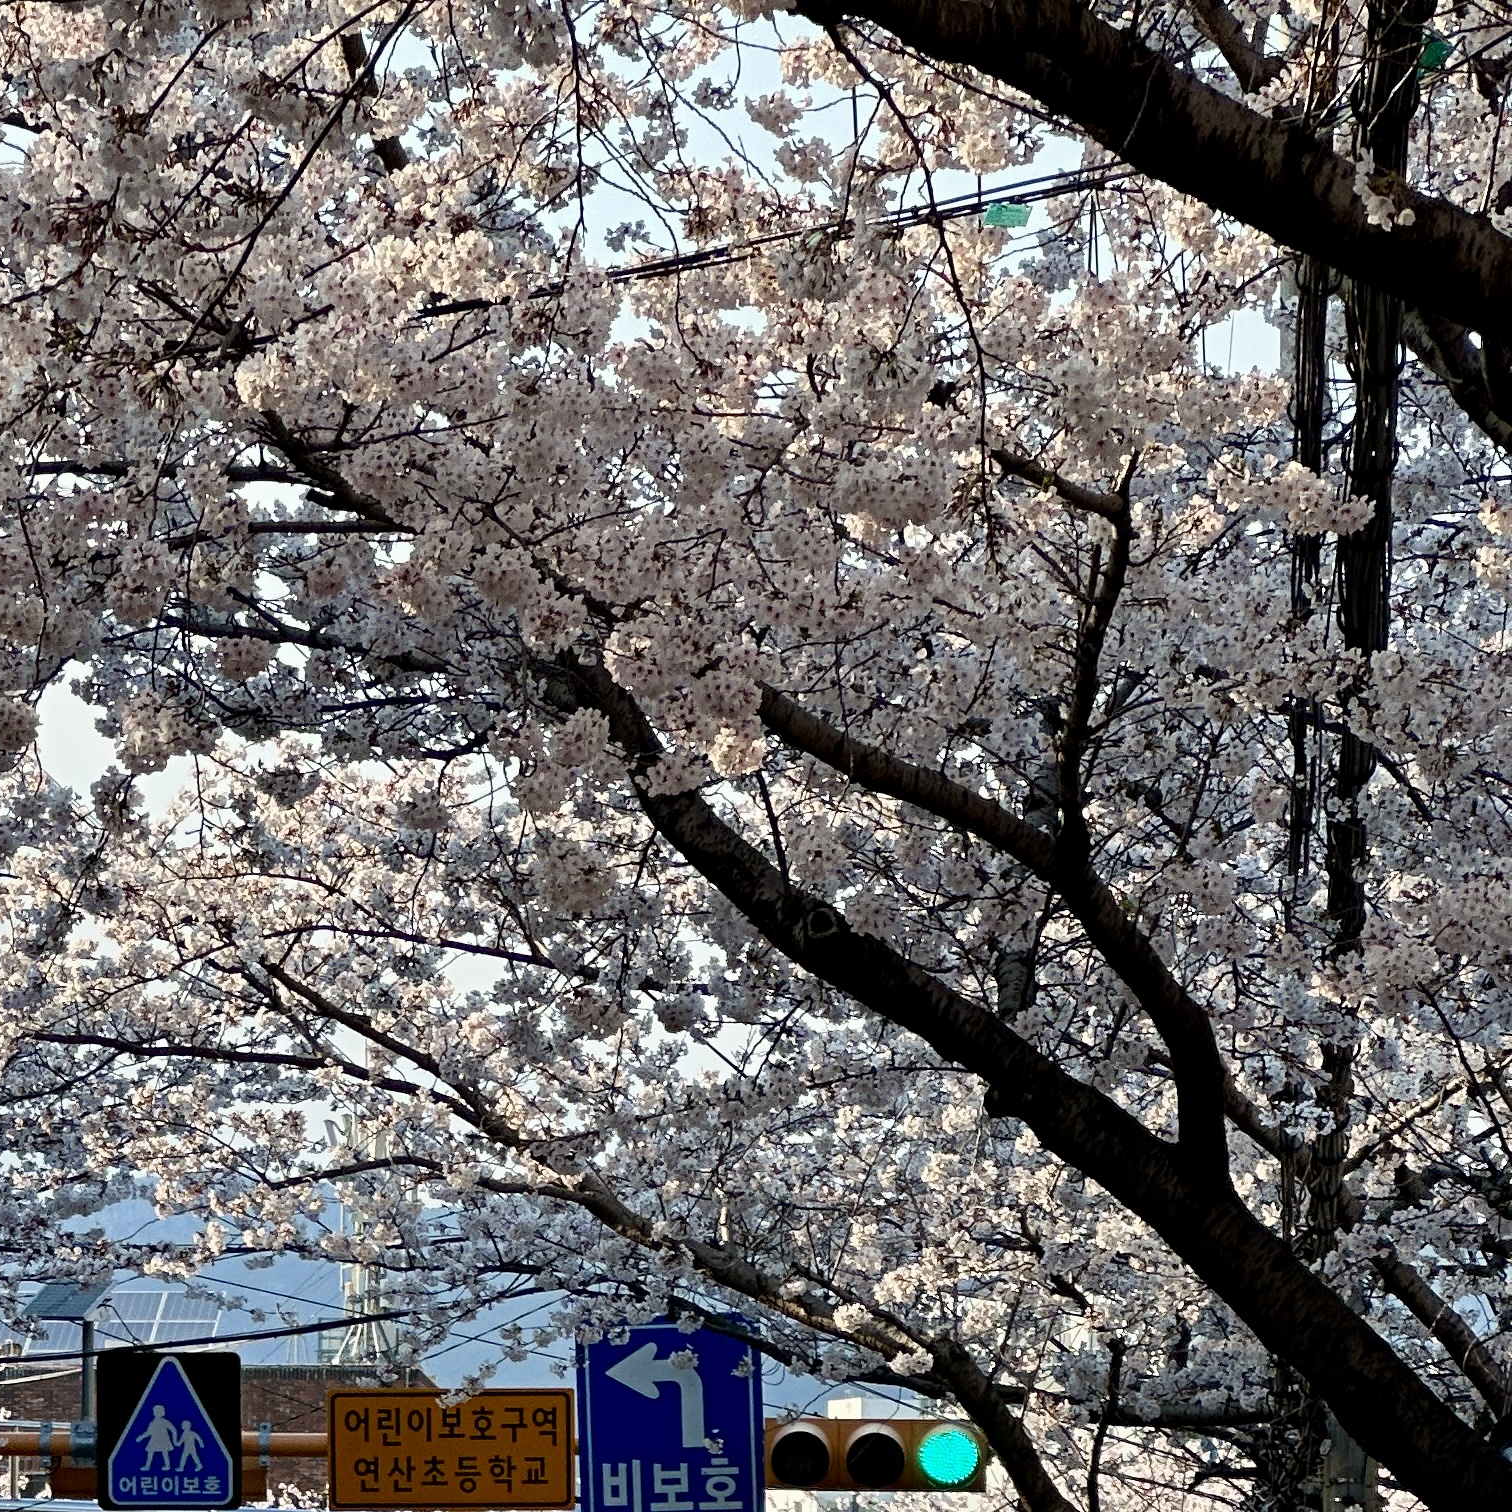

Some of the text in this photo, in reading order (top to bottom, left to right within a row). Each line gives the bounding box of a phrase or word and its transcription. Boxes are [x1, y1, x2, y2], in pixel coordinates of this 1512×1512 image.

[345, 1407, 558, 1447] 어린이보호구역
[119, 1476, 222, 1495] 어린이보호
[353, 1455, 549, 1494] 연산초등학교
